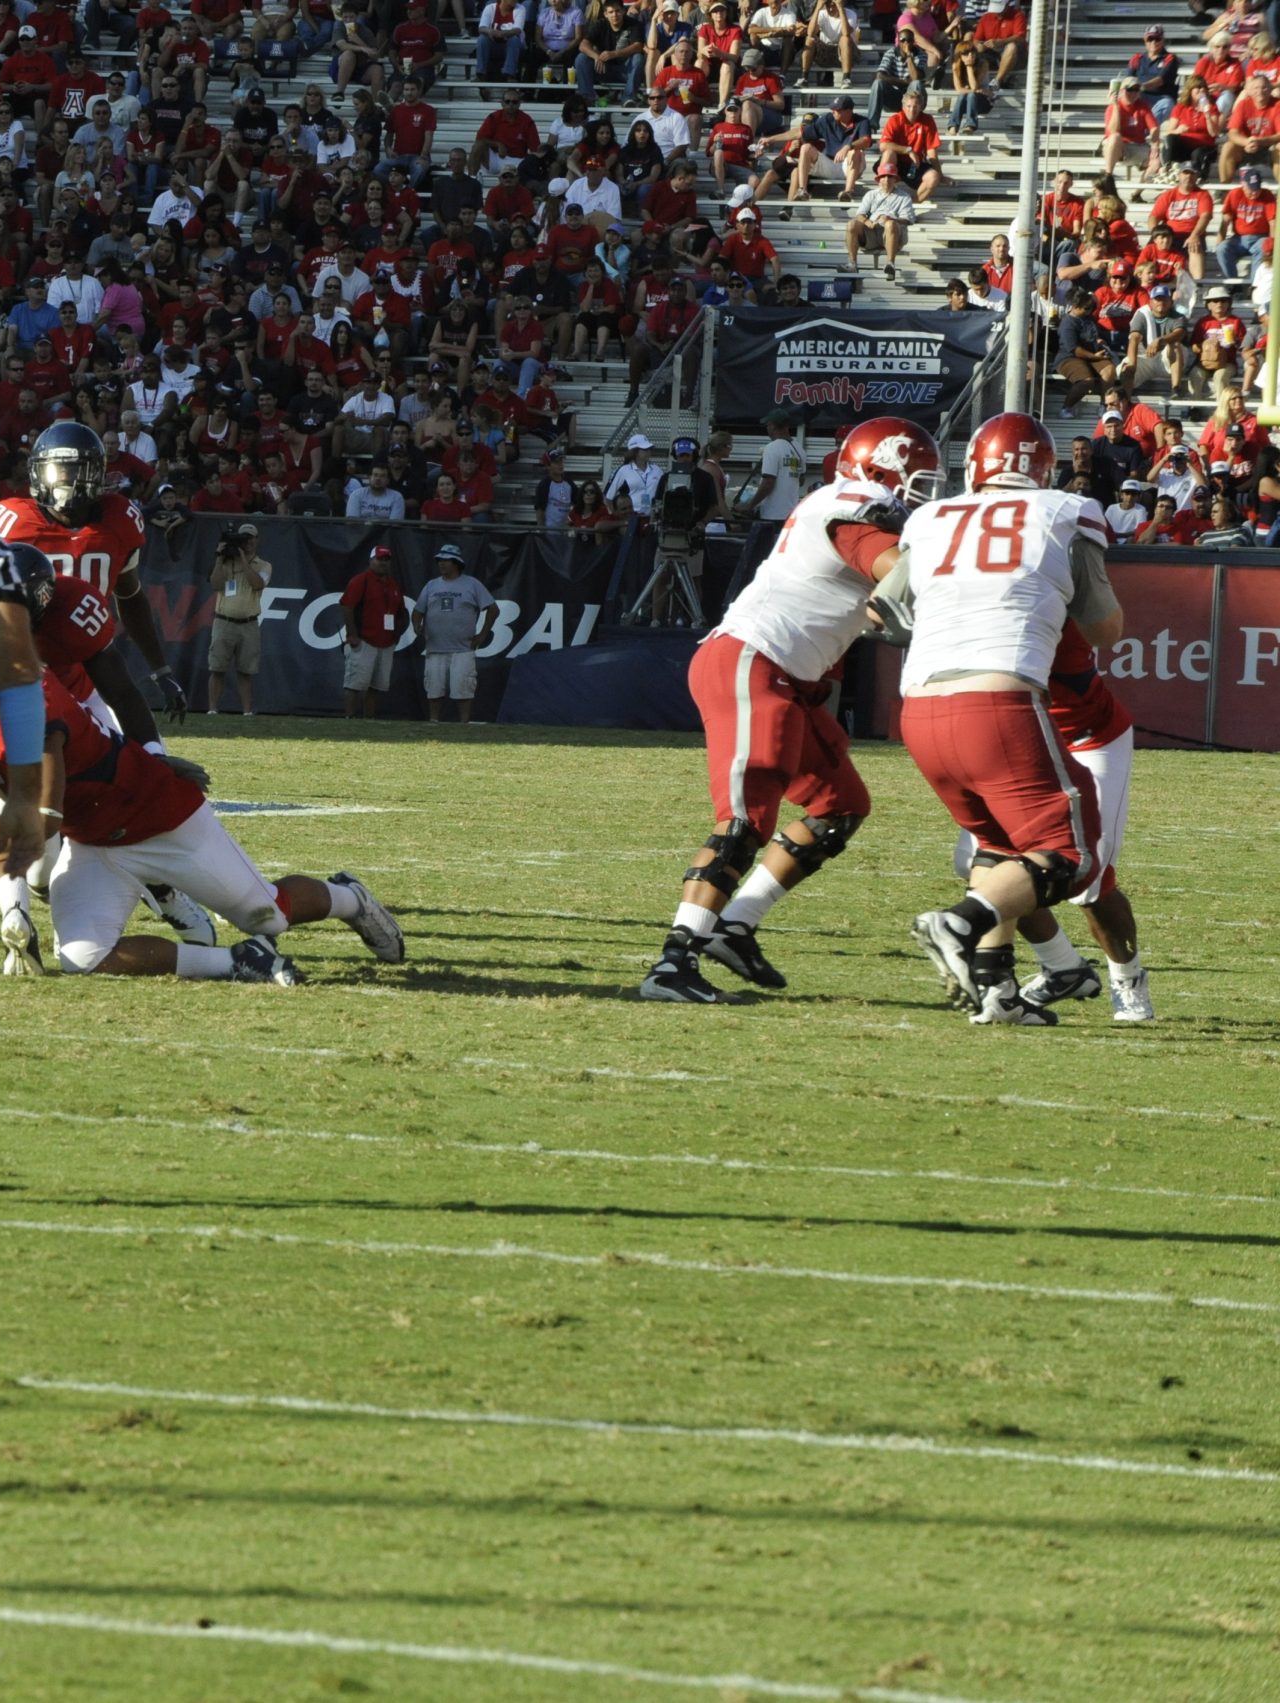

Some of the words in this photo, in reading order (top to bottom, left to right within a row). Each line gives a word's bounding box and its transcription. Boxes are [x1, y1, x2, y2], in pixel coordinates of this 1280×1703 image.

[62, 88, 85, 119] A
[310, 255, 338, 266] ARIZO
[723, 315, 734, 326] 27
[990, 321, 1003, 332] 28
[777, 340, 869, 356] AMERICAN
[876, 341, 942, 357] FAMILY
[789, 359, 927, 371] INSURANCE
[1003, 452, 1029, 473] 78
[126, 499, 145, 534] 2
[932, 500, 1028, 577] 78
[70, 594, 109, 637] 52
[1091, 628, 1210, 681] ate
